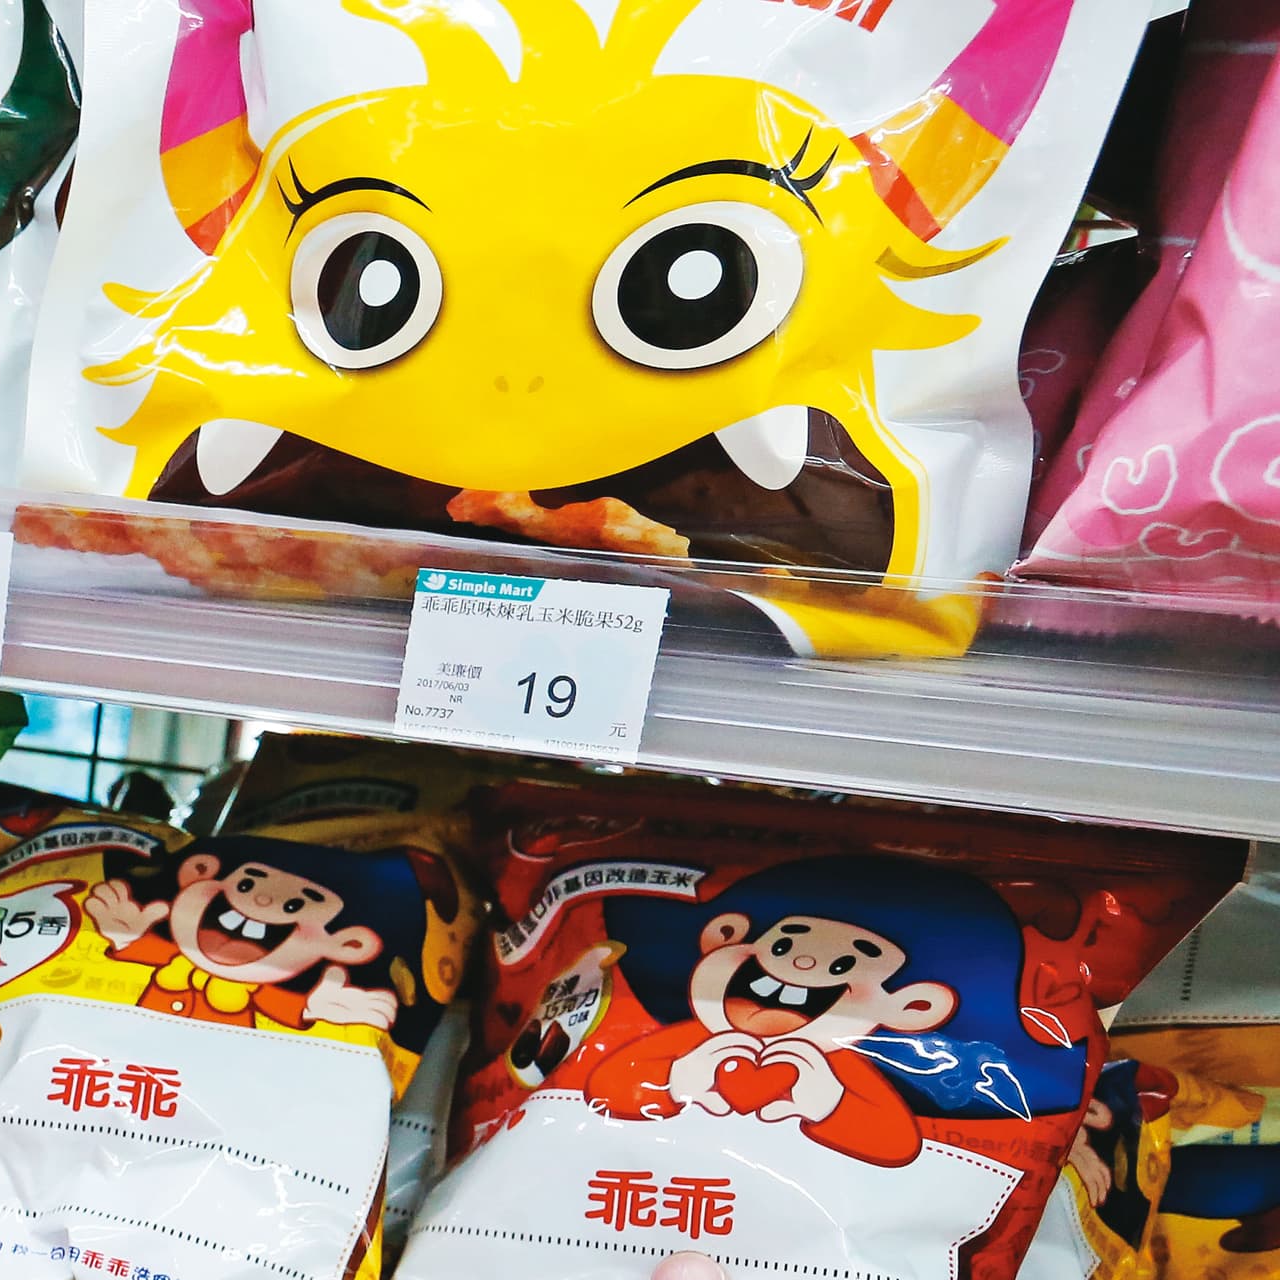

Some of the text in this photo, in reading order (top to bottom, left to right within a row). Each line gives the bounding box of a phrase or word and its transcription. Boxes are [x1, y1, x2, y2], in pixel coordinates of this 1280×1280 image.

[448, 578, 534, 598] Simple Mart
[438, 662, 483, 680] 美廉價
[416, 678, 470, 691] 2017/06/03
[449, 694, 463, 704] NR
[517, 672, 578, 718] 19
[404, 704, 454, 719] No.7737
[609, 722, 627, 738] 元
[5, 911, 68, 938] 5香
[48, 1057, 183, 1122] 乖乖
[584, 1170, 737, 1240] 乖乖
